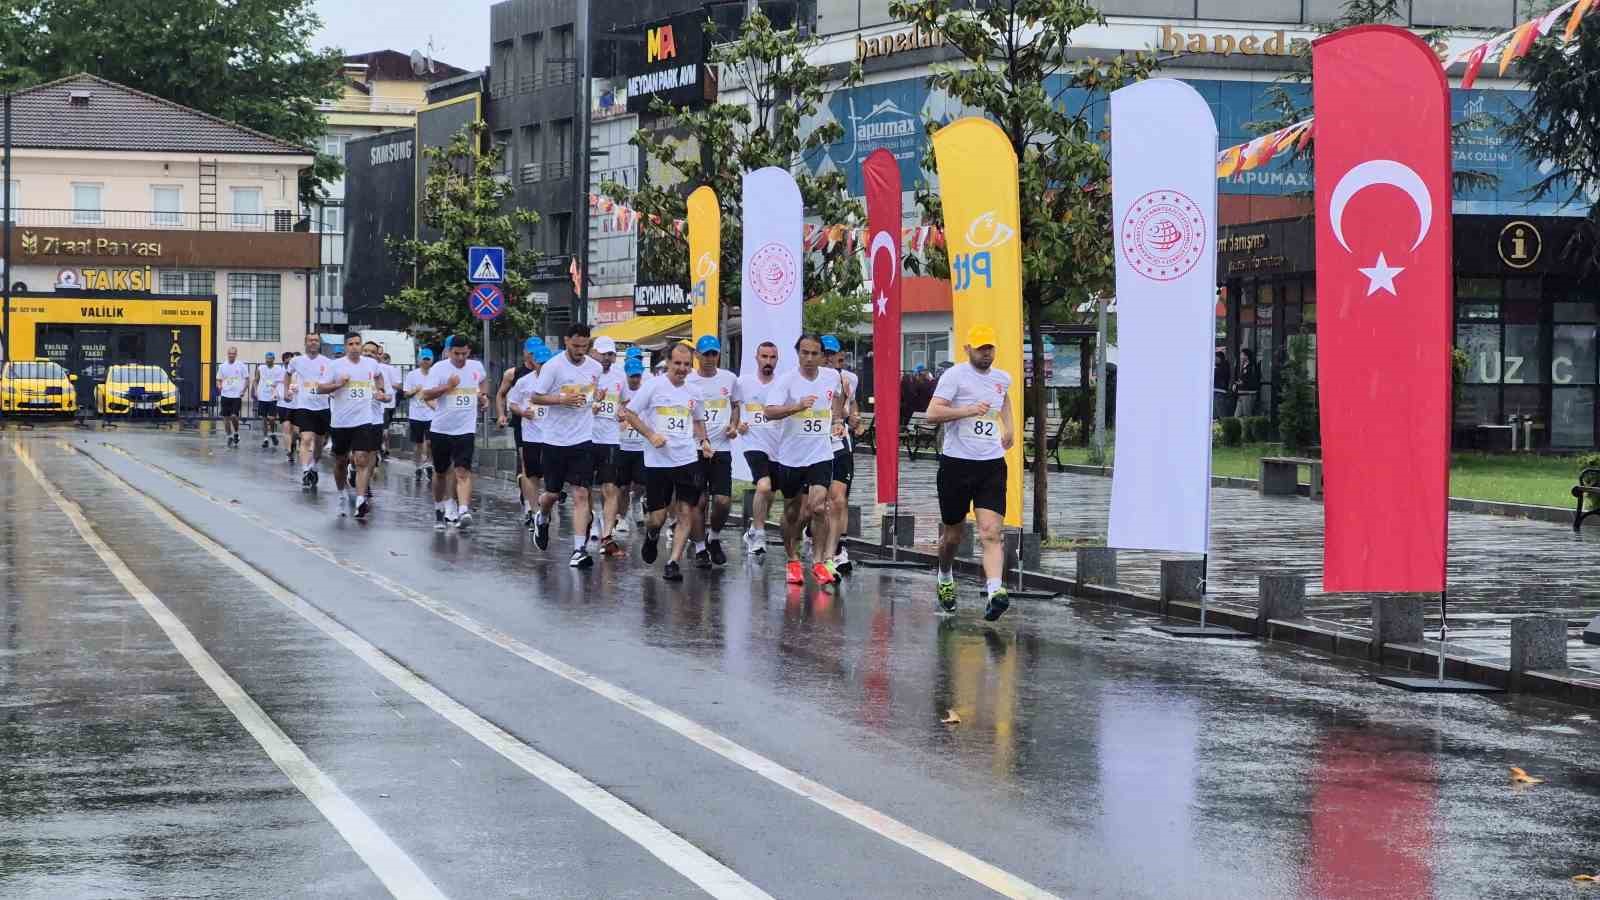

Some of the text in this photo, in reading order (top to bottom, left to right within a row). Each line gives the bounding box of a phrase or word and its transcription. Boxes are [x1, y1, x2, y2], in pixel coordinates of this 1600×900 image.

[1161, 24, 1312, 57] haneda
[627, 72, 658, 97] MEYDAN
[658, 68, 678, 91] PARK
[679, 63, 697, 87] AVM
[370, 140, 413, 166] SAMSUNG
[42, 236, 161, 257] Ziraat Bankası
[81, 264, 152, 291] TAKSİ
[634, 284, 665, 306] MEYDAN
[665, 283, 685, 304] PARK
[80, 306, 124, 318] VALİLİK
[350, 388, 364, 398] 33
[456, 395, 471, 406] 59
[600, 401, 614, 414] 38
[667, 417, 684, 430] 34
[803, 419, 822, 433] 35
[974, 420, 993, 437] 82
